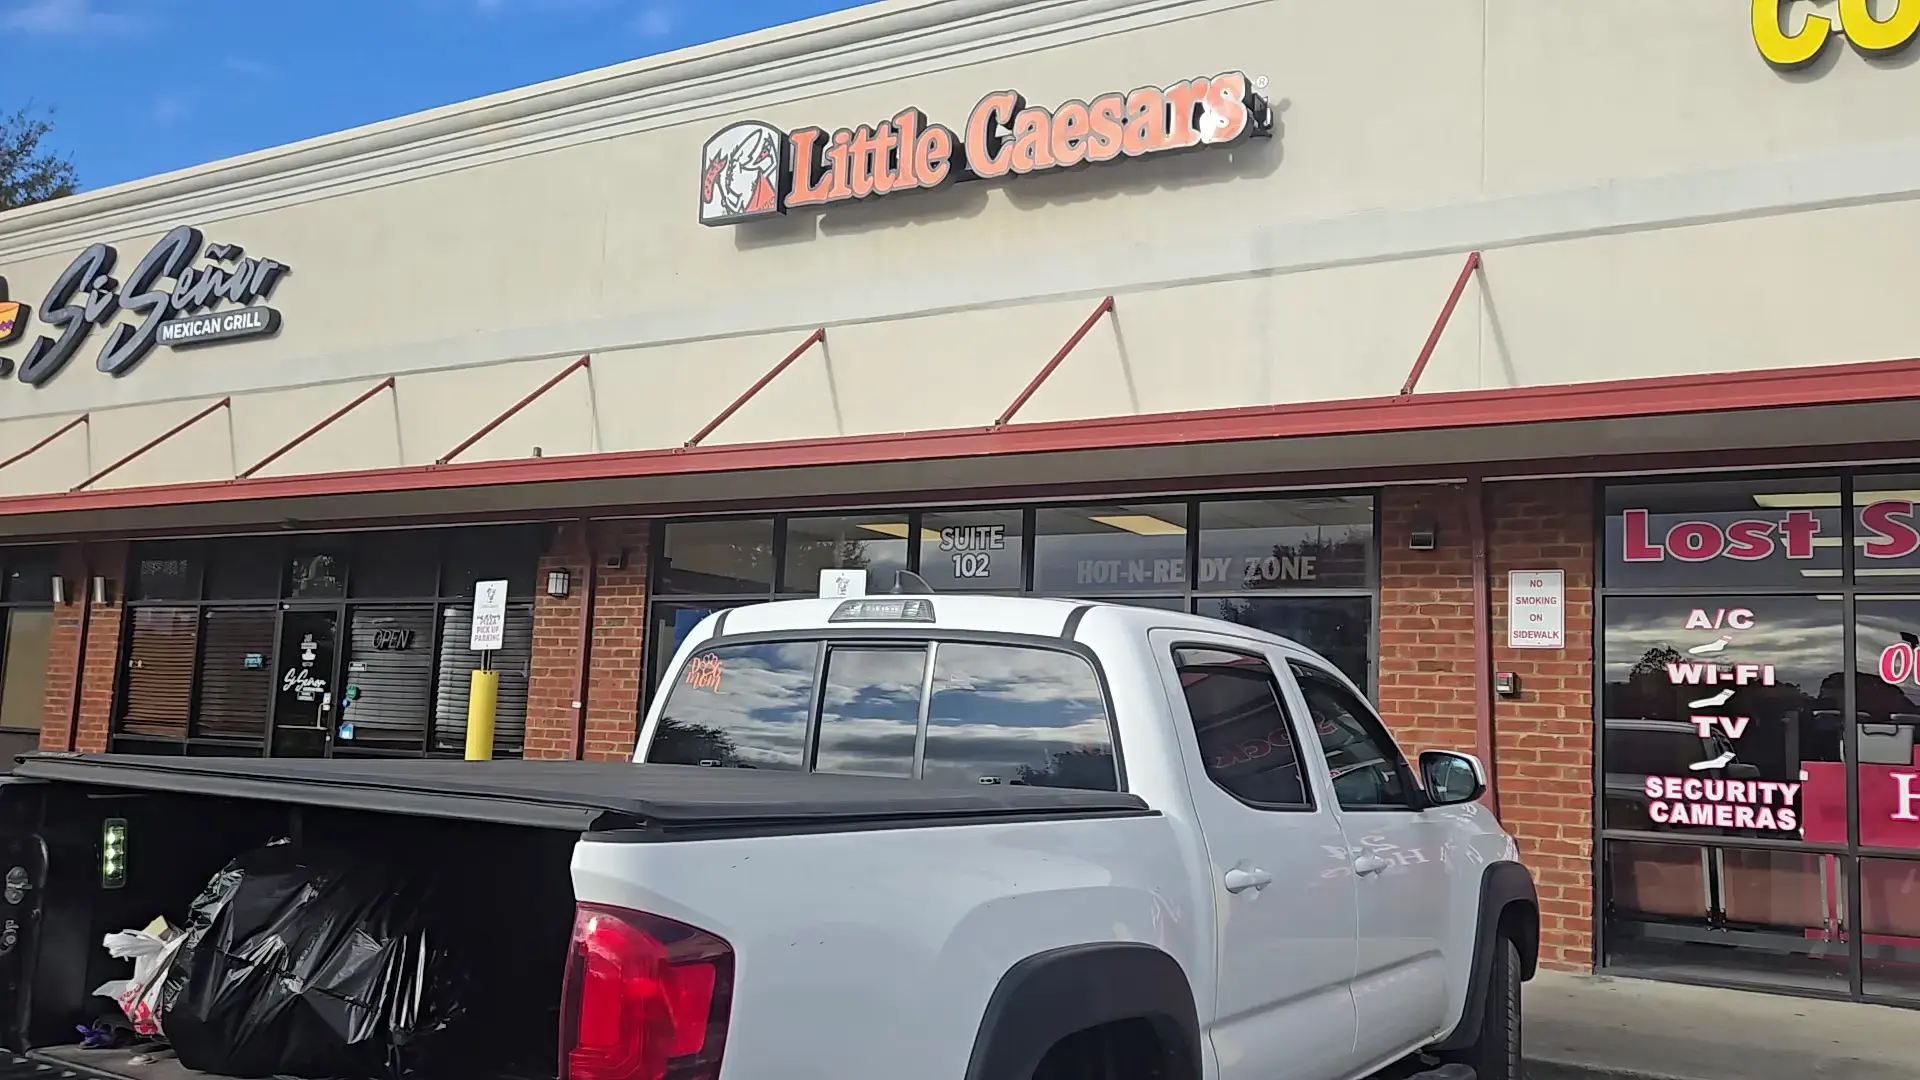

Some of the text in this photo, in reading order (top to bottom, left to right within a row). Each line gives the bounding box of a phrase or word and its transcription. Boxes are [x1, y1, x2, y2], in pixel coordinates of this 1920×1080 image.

[785, 71, 1248, 208] Little Caesars
[96, 225, 288, 374] Señor
[162, 312, 262, 340] MEXICAN GRILL
[939, 525, 1005, 551] SUITE
[952, 552, 990, 578] 102
[1077, 556, 1317, 584] HOT-N-REDY ZONE
[1529, 579, 1543, 588] NO
[1515, 596, 1557, 605] SMOKING
[1529, 613, 1543, 622] ON
[1685, 608, 1755, 630] A/C
[372, 629, 410, 649] OPEN
[474, 633, 500, 641] PARKING
[476, 626, 500, 634] PICK UP
[1513, 630, 1560, 639] SIDEWALK
[1667, 663, 1775, 686] WI-FI
[1690, 715, 1750, 739] TV
[1645, 776, 1801, 806] SECURITY
[1648, 801, 1797, 831] CAMERAS
